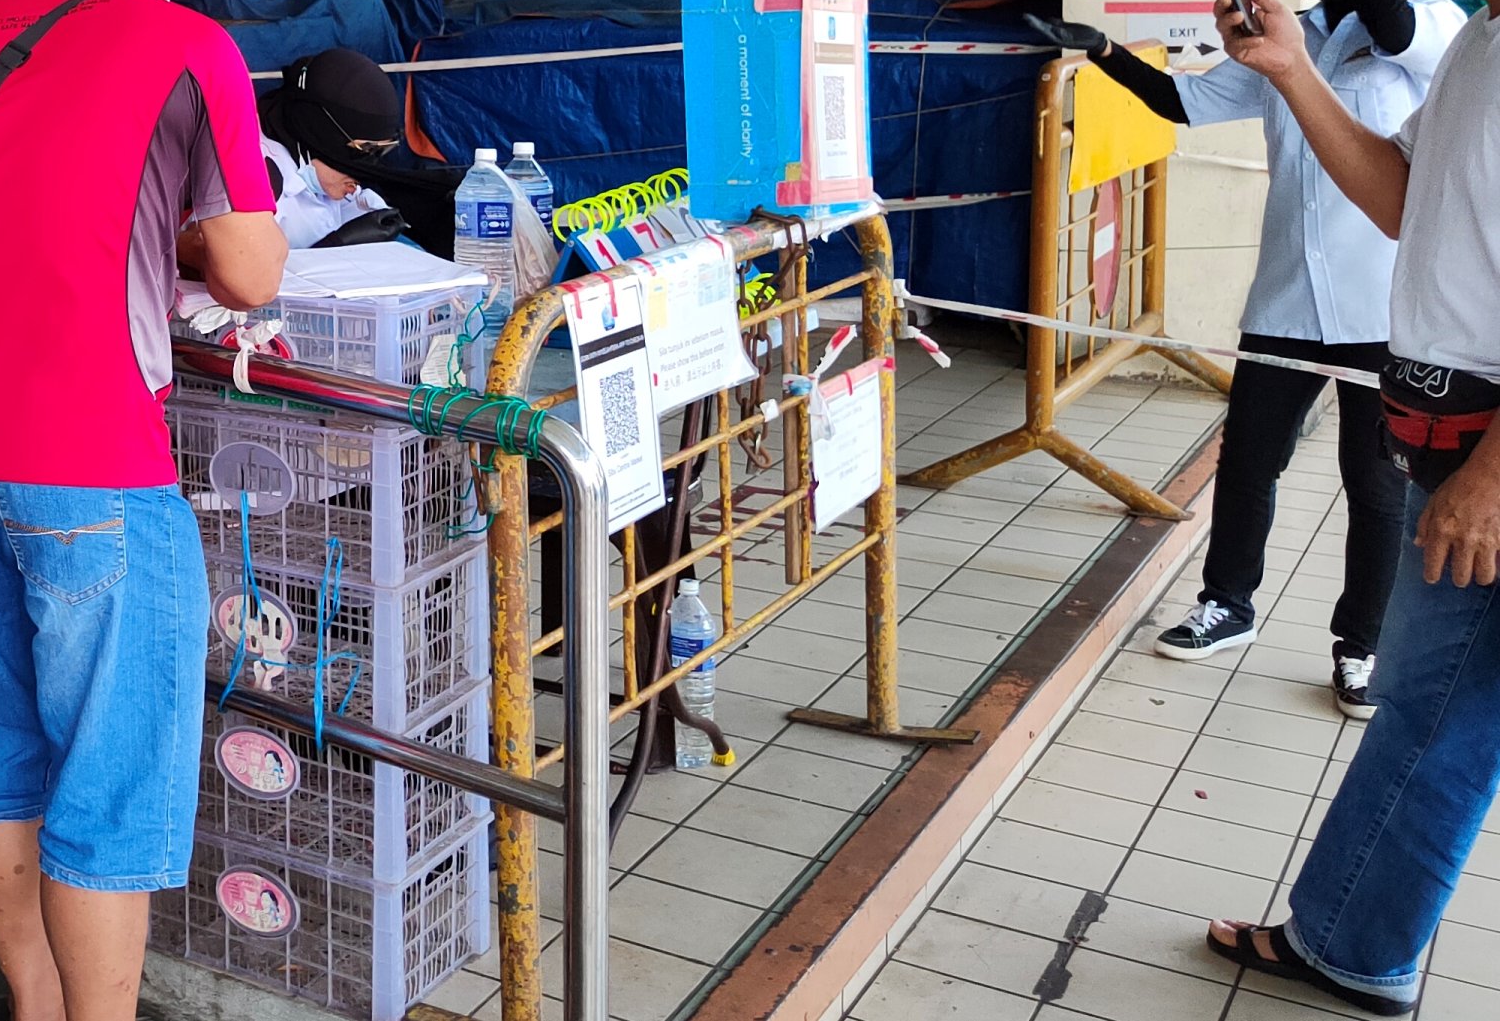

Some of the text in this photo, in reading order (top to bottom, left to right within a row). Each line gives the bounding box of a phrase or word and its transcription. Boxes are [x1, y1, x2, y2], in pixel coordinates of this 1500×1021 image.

[1169, 27, 1198, 38] EXIT
[739, 46, 751, 100] moment
[740, 103, 752, 117] of
